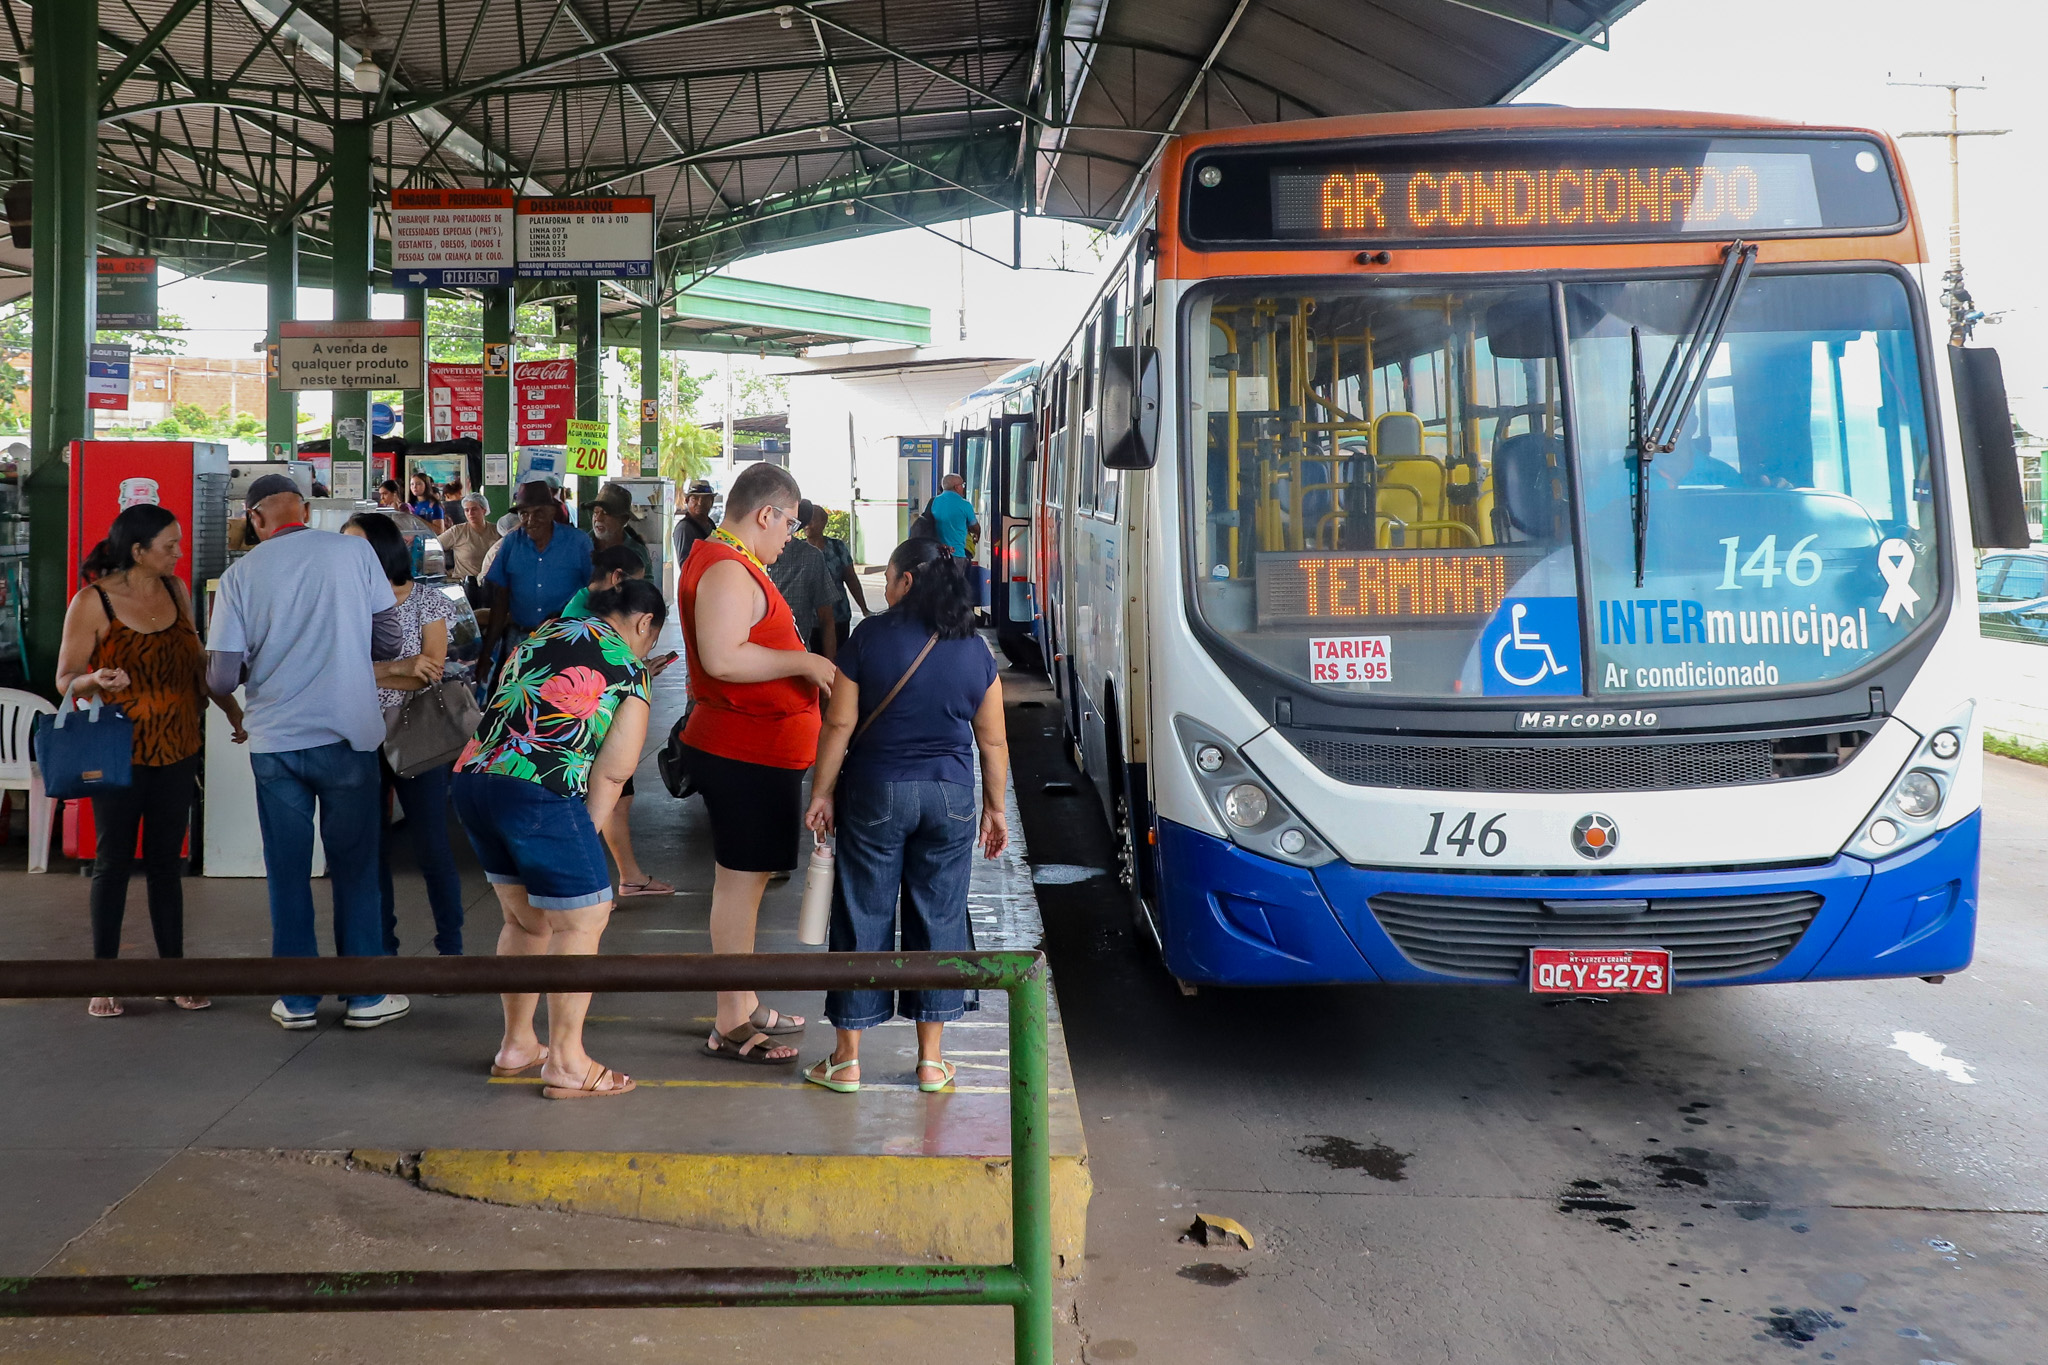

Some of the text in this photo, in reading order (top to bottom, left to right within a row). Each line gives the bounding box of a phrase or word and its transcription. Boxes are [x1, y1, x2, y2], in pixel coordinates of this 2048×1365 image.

[399, 194, 503, 206] EMBARQUE PREFERENCIAL
[1319, 165, 1760, 229] AR CONDICIONADO
[530, 200, 614, 213] DESEMBARQUE
[398, 214, 502, 224] EMBARQUE PARA PORTADORES DE
[529, 216, 572, 224] PLATAFORMA
[398, 228, 440, 236] NECESSIDADES
[443, 228, 472, 236] ESPECIAIS
[440, 240, 467, 249] OBESOS,
[445, 252, 471, 263] CRIANÇA
[486, 252, 503, 260] COLO.
[315, 322, 385, 335] PROIBIDO
[313, 343, 387, 353] A venda de
[292, 358, 409, 371] qualquer produto
[515, 362, 570, 380] Coca-Cola
[300, 374, 400, 385] neste terminal.
[576, 447, 608, 470] 2,00
[1715, 534, 1823, 590] 146
[1314, 640, 1385, 659] TARIFA
[1314, 662, 1387, 682] R$ 5,95
[1604, 660, 1779, 688] Ar condicionado
[1520, 710, 1658, 728] Marcopolo
[1420, 811, 1508, 857] 146
